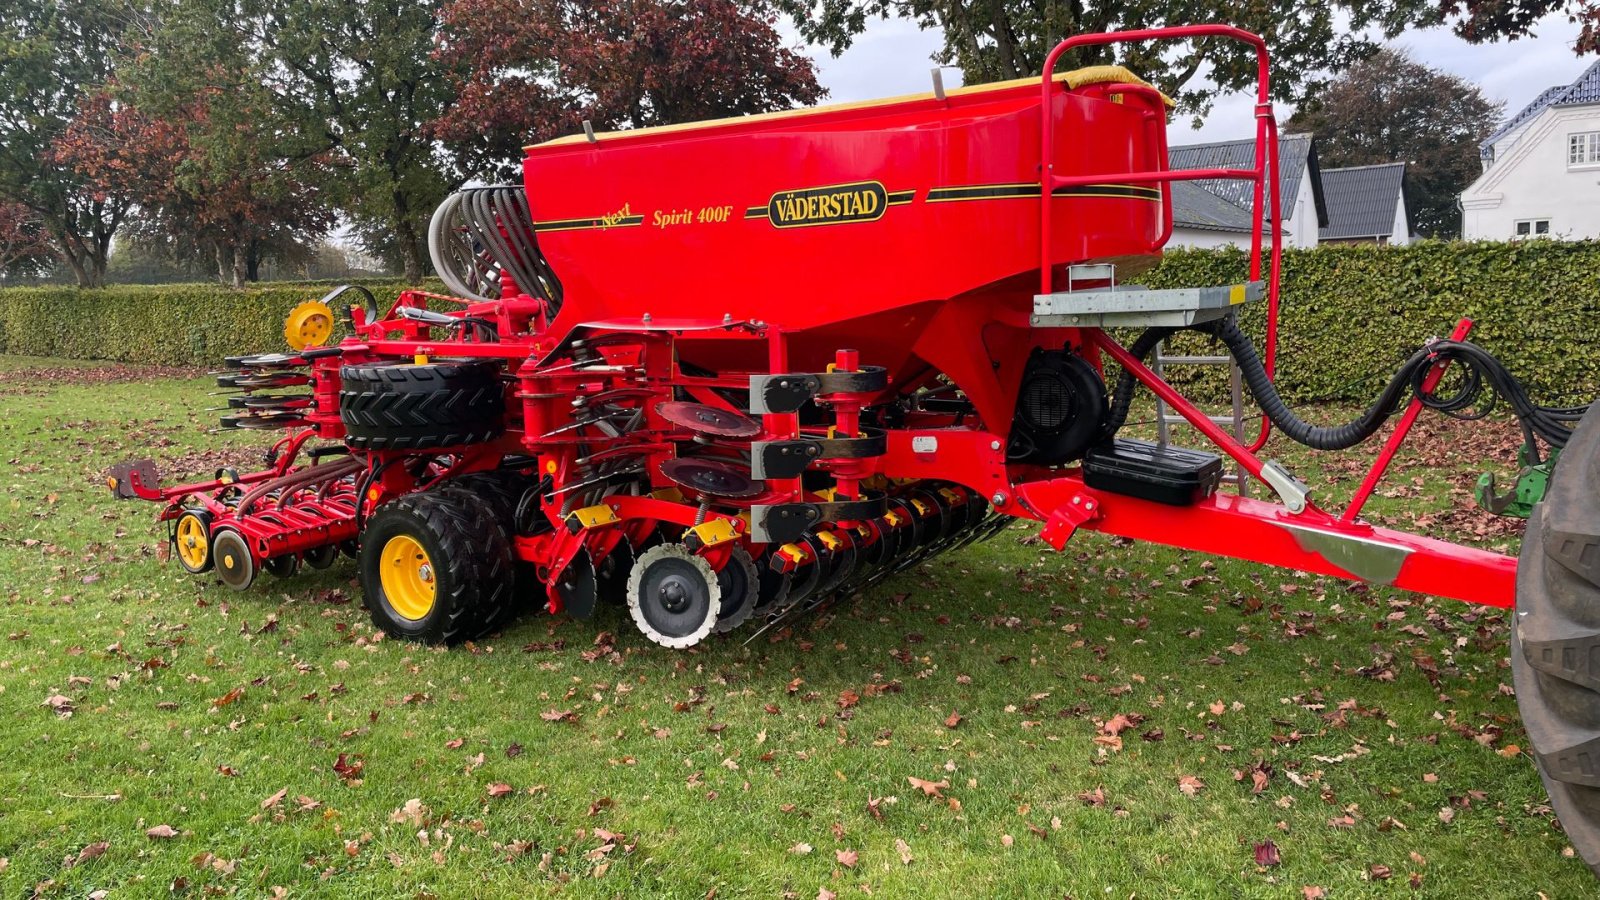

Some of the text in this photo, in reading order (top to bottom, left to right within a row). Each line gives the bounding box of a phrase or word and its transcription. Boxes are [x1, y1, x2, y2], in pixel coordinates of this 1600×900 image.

[601, 202, 631, 231] Next
[652, 205, 733, 230] Spirit 400F
[775, 189, 878, 222] VÄDERSTAD
